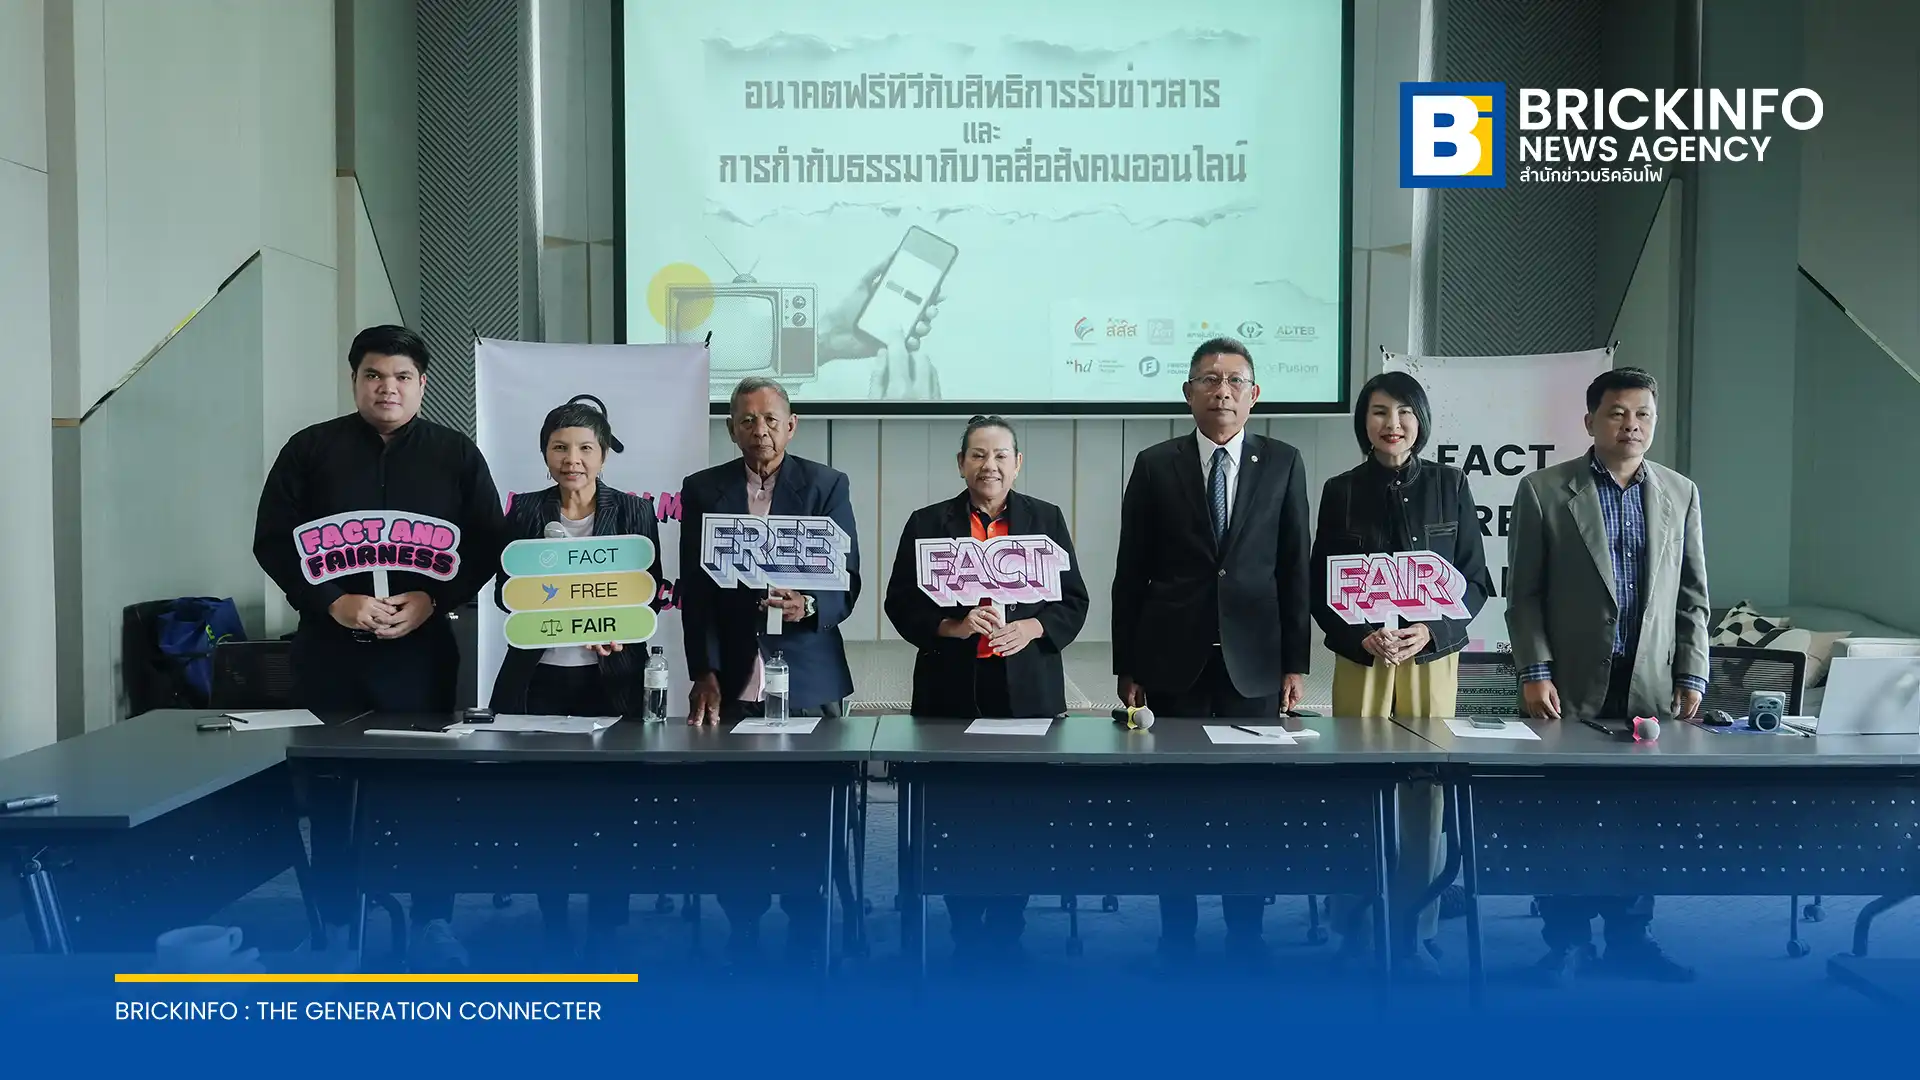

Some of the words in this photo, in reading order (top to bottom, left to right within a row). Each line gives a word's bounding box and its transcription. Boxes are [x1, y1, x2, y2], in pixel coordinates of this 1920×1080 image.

[745, 62, 1220, 109] อนาคตฟรีทีวีกับสิทธิการรับข่าวสาร
[963, 121, 1001, 144] และ
[719, 138, 1248, 183] การกำกับธรรมาภิบาลสื่อสังคมออนไลน์
[1437, 444, 1555, 476] FACT
[299, 517, 386, 555] FACT
[388, 518, 455, 551] AND
[702, 516, 838, 578] FREE
[306, 543, 456, 579] FAIRNESS
[568, 548, 619, 565] FACT
[919, 539, 1056, 592] FACT
[570, 582, 618, 599] FREE
[1330, 554, 1456, 612] FAIR
[571, 617, 617, 634] FAIR
